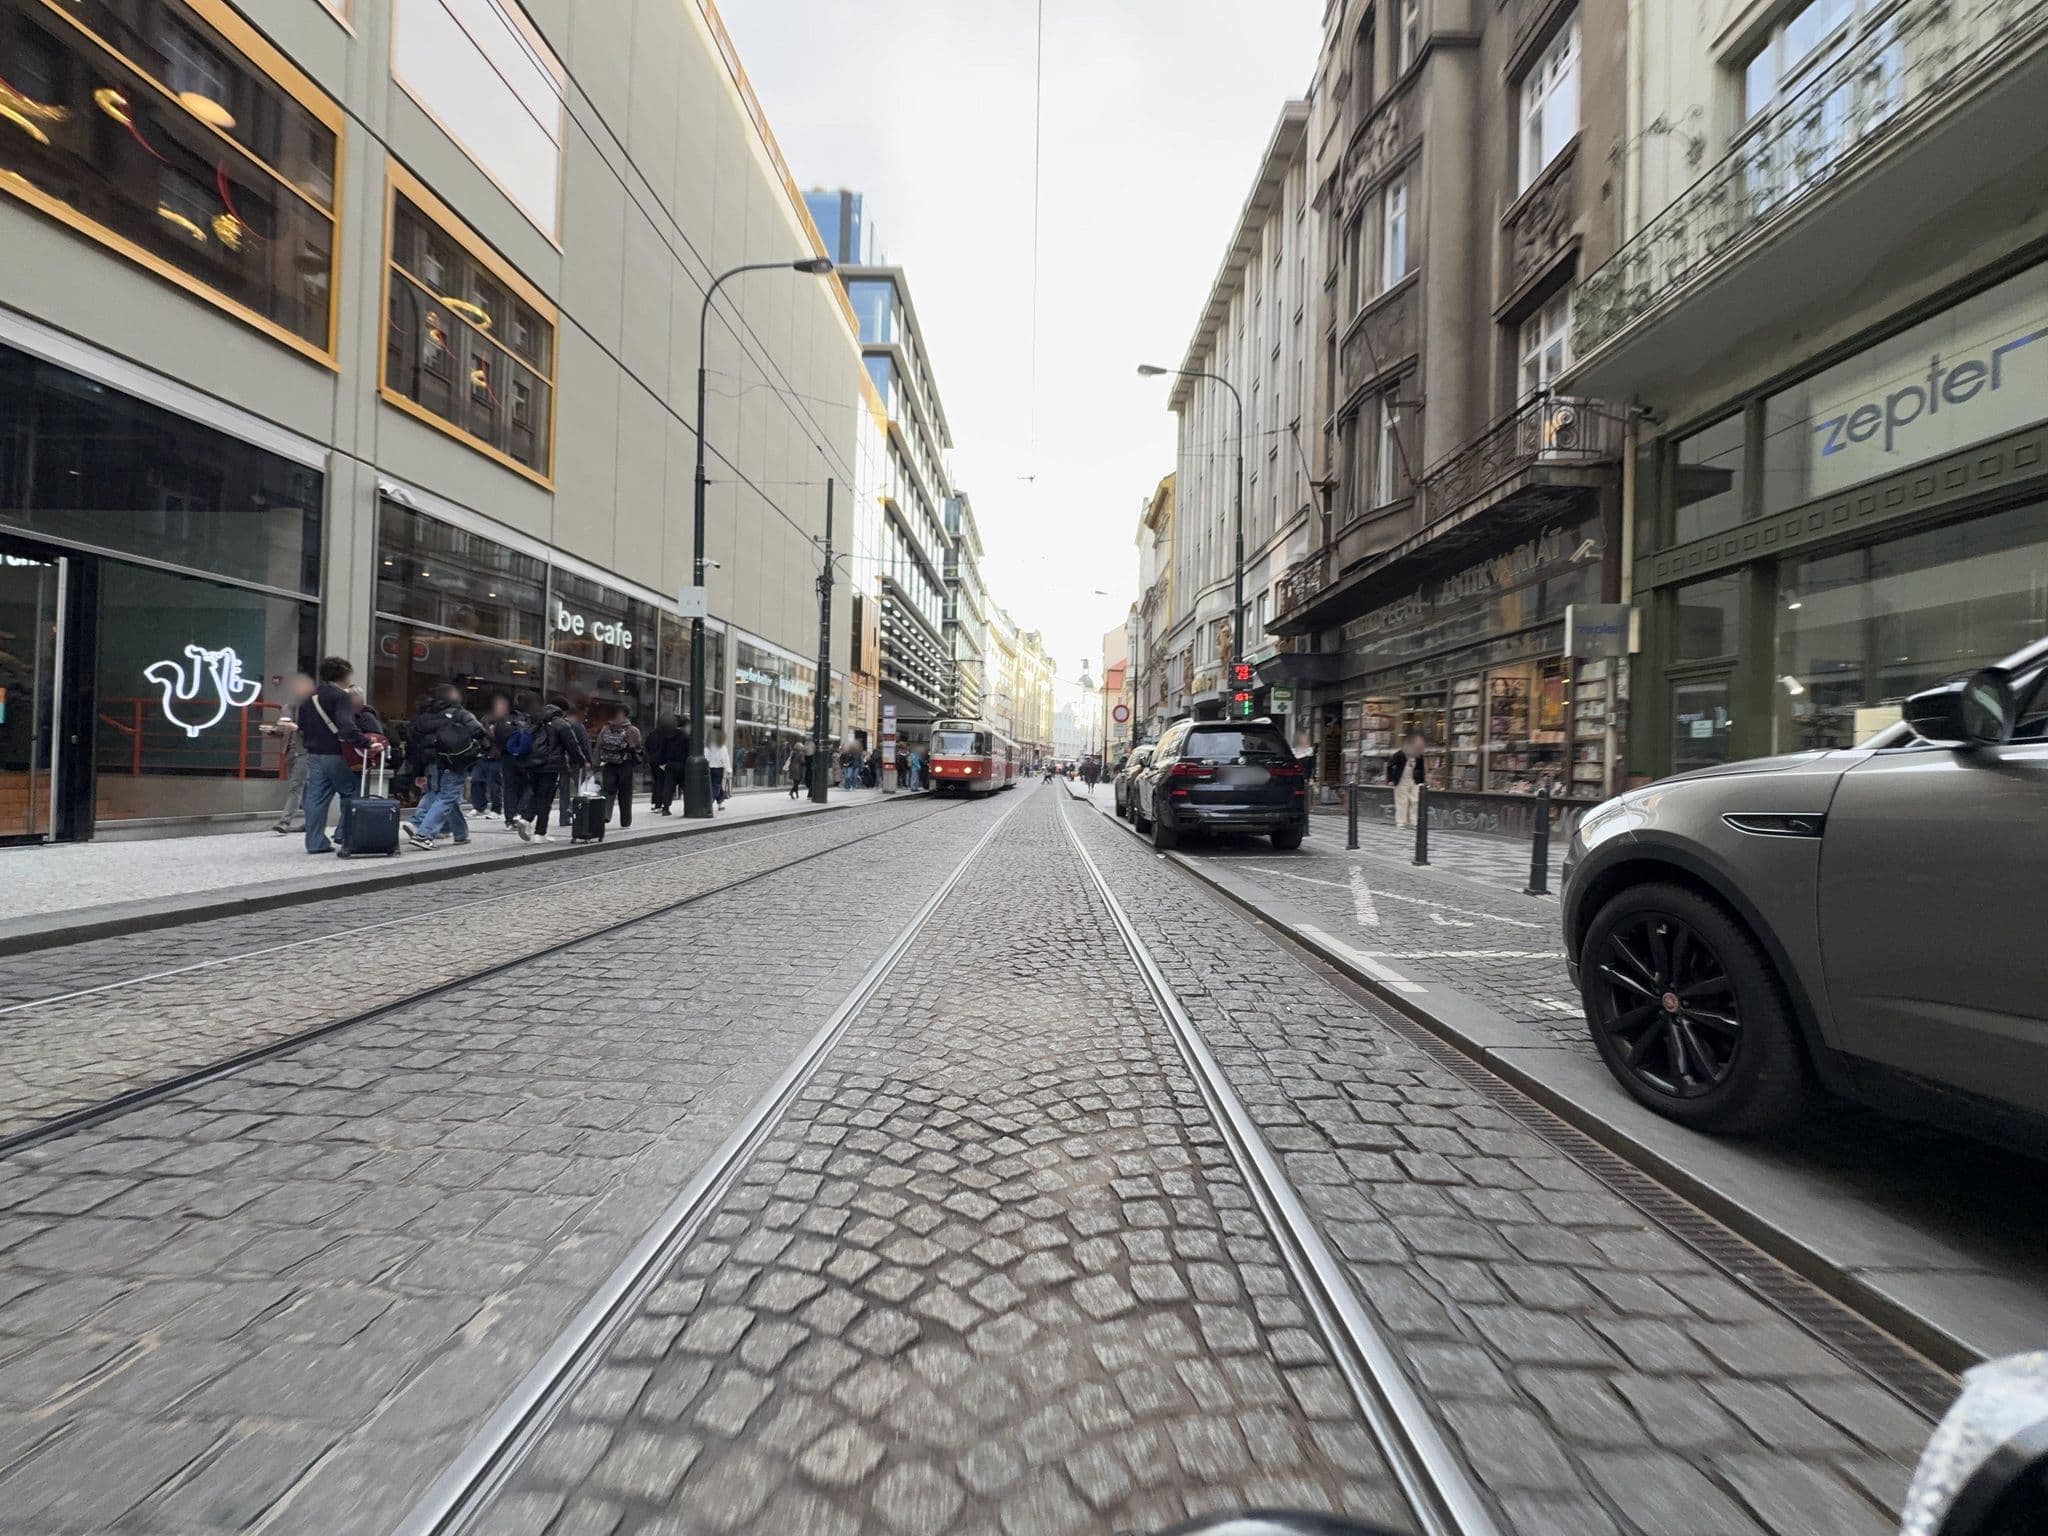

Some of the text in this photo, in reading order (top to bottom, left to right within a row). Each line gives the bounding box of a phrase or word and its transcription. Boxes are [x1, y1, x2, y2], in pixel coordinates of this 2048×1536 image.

[1811, 327, 2048, 457] zepter
[1441, 524, 1563, 604] ANTIKVARIÁT
[558, 601, 633, 650] be cafe
